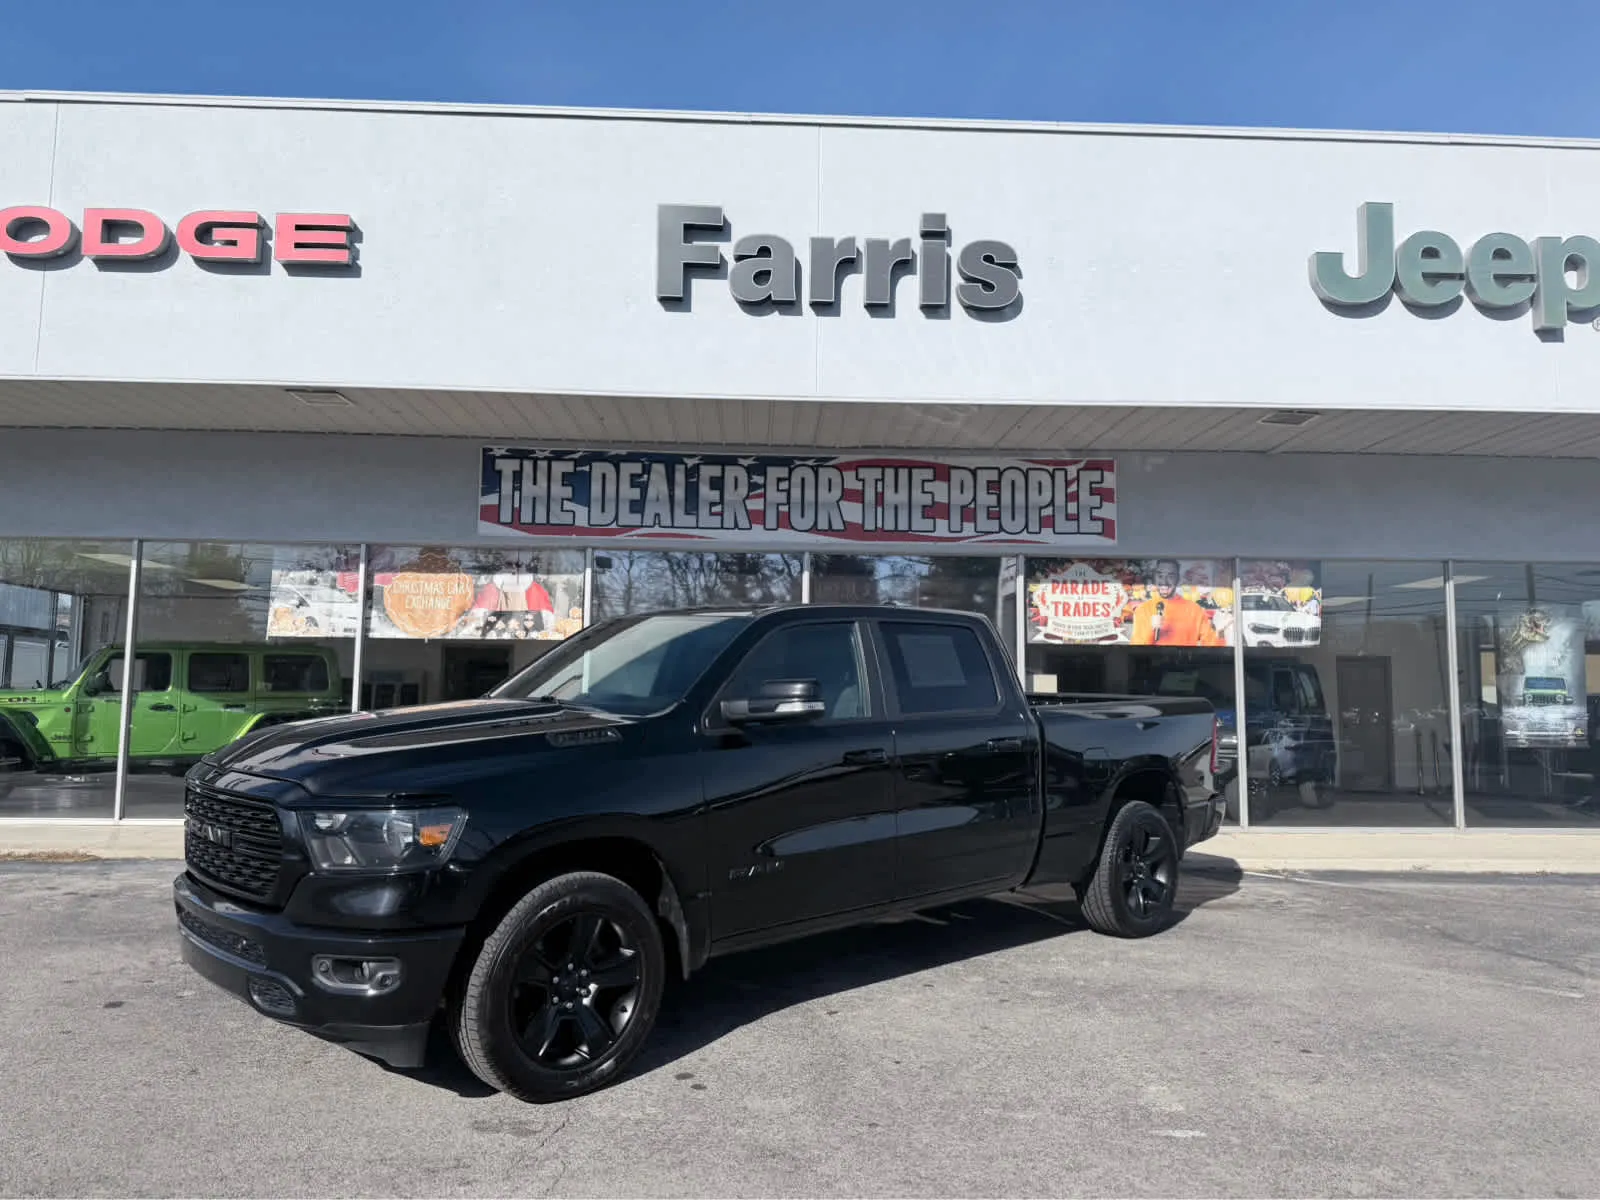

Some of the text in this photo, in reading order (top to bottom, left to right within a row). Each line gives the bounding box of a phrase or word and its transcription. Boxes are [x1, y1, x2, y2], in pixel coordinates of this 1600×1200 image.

[0, 205, 353, 264] ODGE
[656, 203, 1020, 309] Farris
[1308, 201, 1600, 329] Jeep
[495, 457, 1105, 535] THE DEALER FOR THE PEOPLE
[1052, 580, 1109, 595] PARADE
[1052, 601, 1110, 617] TRADES
